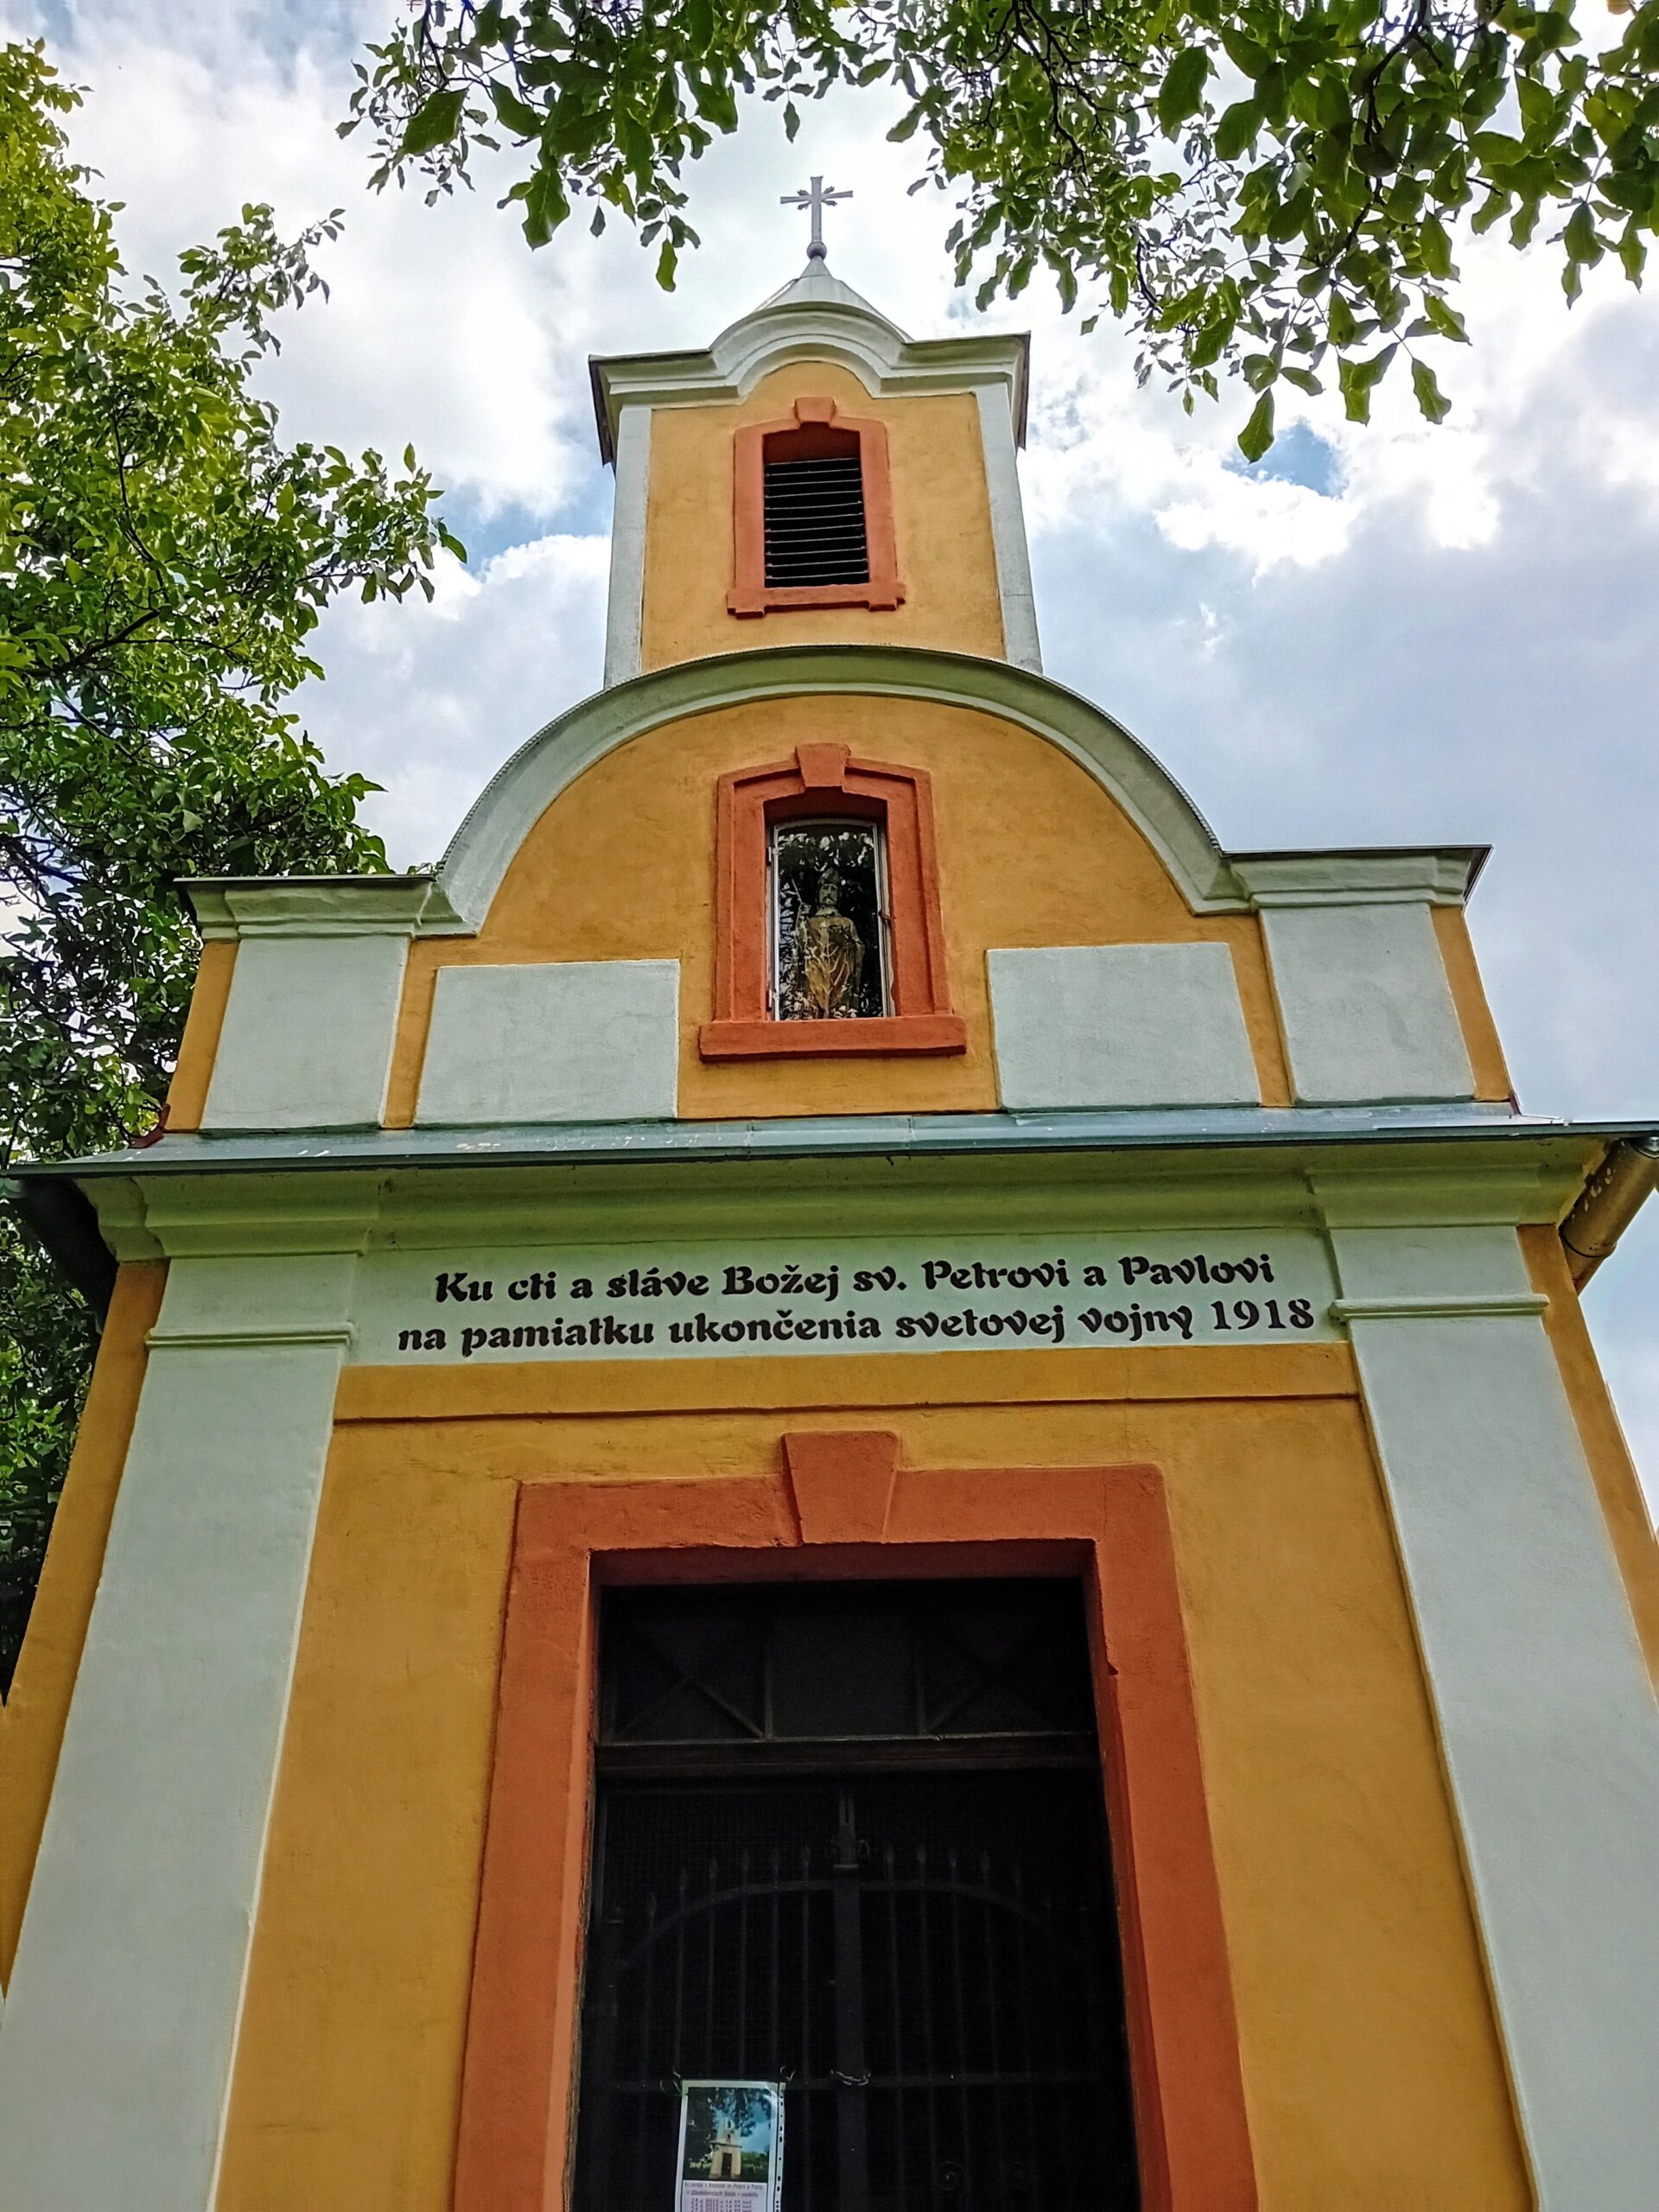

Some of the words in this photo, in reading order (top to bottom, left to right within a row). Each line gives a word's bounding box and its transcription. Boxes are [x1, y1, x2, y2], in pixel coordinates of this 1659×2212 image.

[435, 1272, 493, 1302] Ku
[508, 1271, 557, 1301] cti
[569, 1278, 594, 1300] a
[605, 1267, 709, 1299] sláve
[721, 1264, 839, 1302] Božej
[853, 1265, 907, 1293] sv.
[920, 1258, 1071, 1291] Petrovi
[1083, 1265, 1108, 1287] a
[1117, 1253, 1275, 1286] Pavlovi
[397, 1328, 447, 1351] na
[461, 1315, 654, 1357] pamiatku
[668, 1309, 882, 1344] ukončenia
[895, 1304, 1065, 1344] svetovej
[1077, 1302, 1193, 1342] vojny
[1211, 1298, 1315, 1331] 1918
